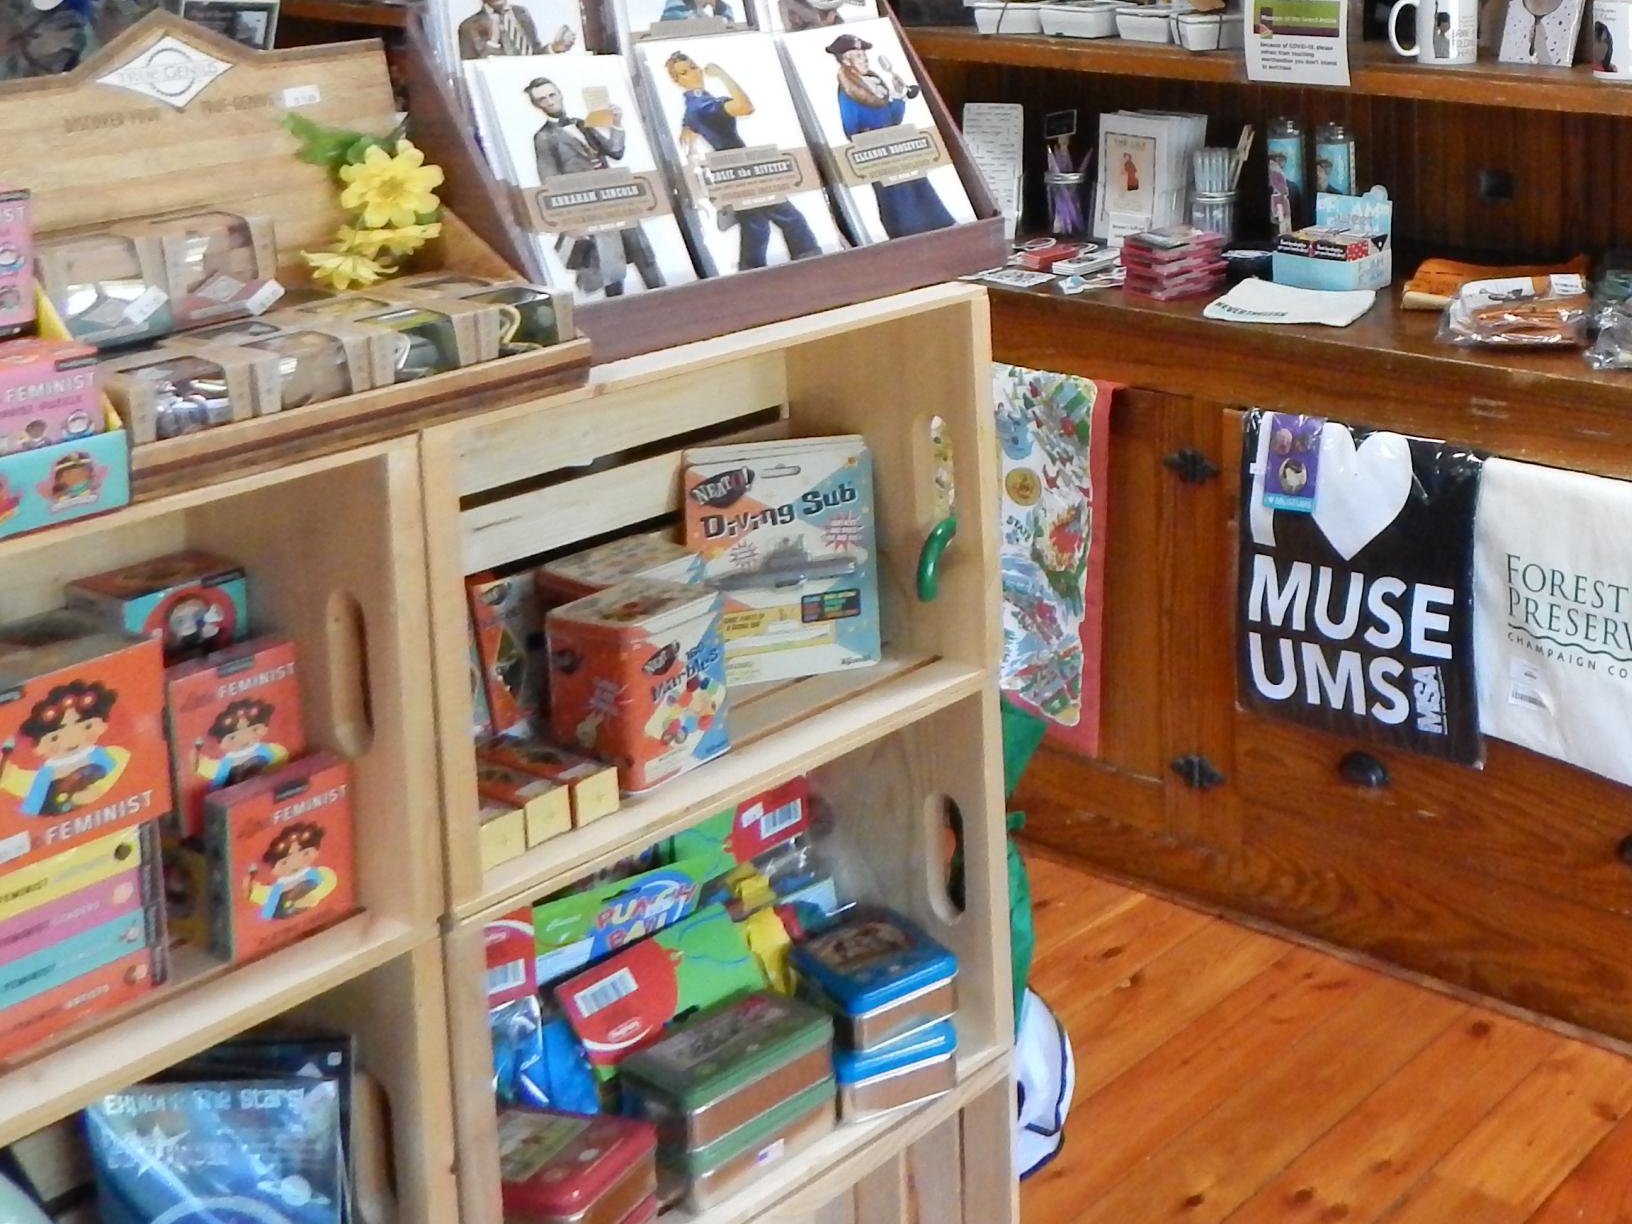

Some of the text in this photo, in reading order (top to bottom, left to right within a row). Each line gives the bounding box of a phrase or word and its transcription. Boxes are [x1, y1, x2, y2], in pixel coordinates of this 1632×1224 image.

[551, 186, 639, 207] ABRAHAM LINCOLN
[5, 372, 95, 402] FEMINIST
[693, 466, 750, 503] NEATO!
[700, 503, 795, 539] Diving
[800, 482, 857, 516] Sub
[1506, 552, 1629, 614] FOREST
[1248, 553, 1455, 659] MUSE
[1507, 632, 1596, 670] CHAMPAIGN
[218, 662, 296, 698] FEMINIST
[1249, 631, 1410, 725] UMS
[46, 789, 153, 845] FEMINIST
[271, 783, 348, 824] FEMINIST
[597, 883, 699, 929] PUNCH
